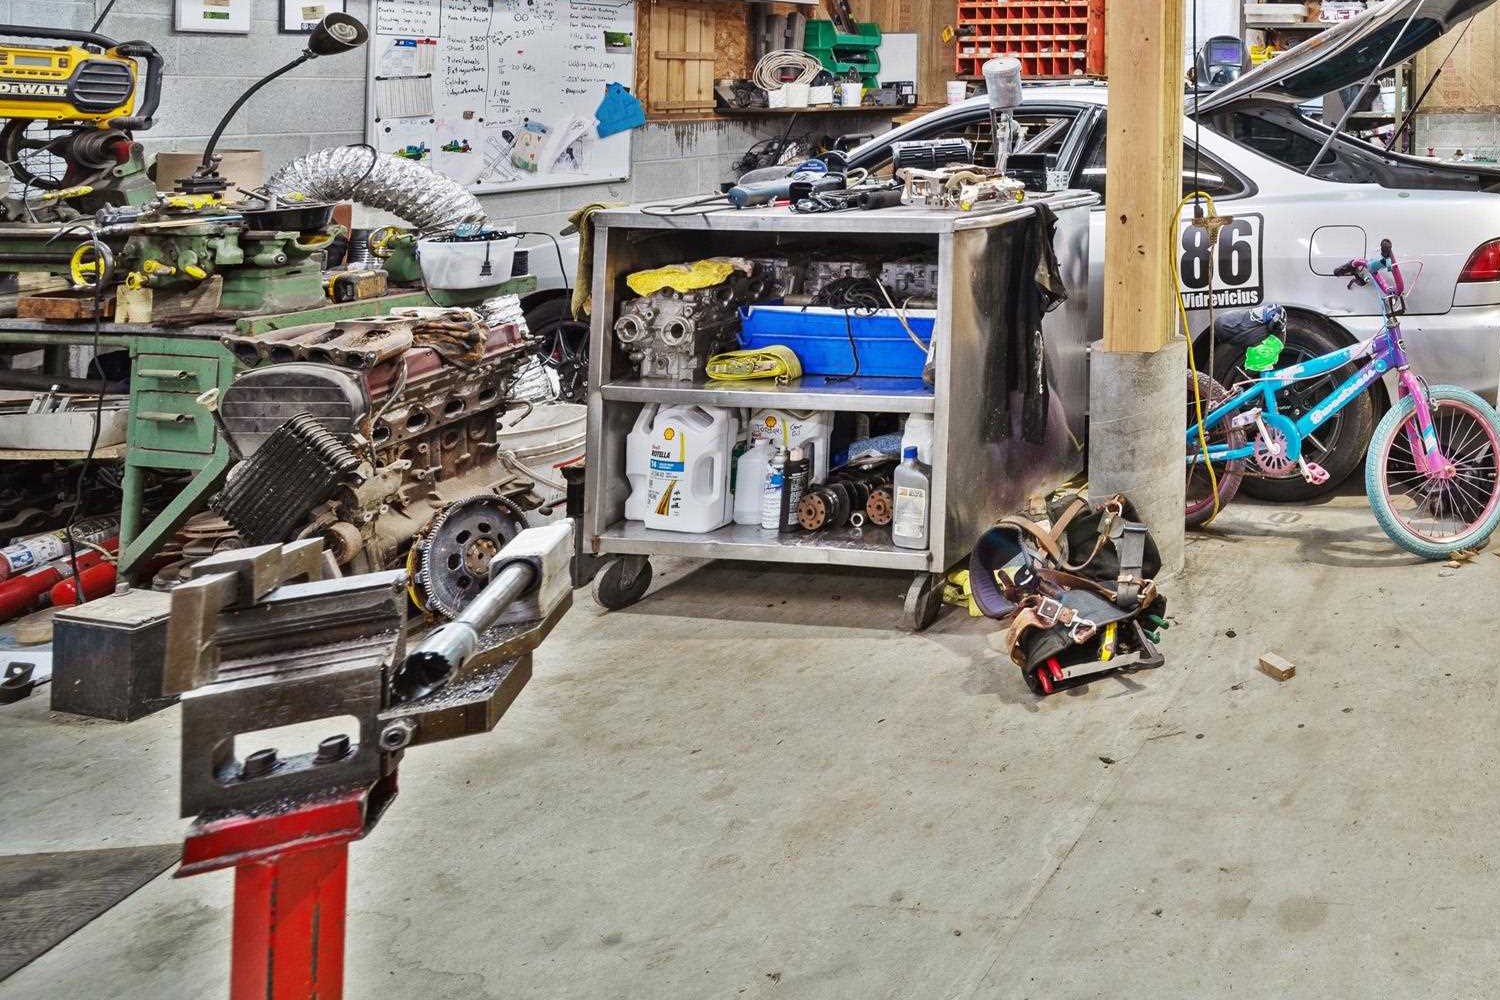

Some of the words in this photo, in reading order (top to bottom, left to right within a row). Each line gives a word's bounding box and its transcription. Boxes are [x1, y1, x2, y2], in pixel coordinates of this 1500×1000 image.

[0, 83, 68, 97] DEWALT
[1180, 218, 1252, 290] 86
[1181, 289, 1259, 308] Vidrevicius
[651, 450, 671, 459] ROTELLA
